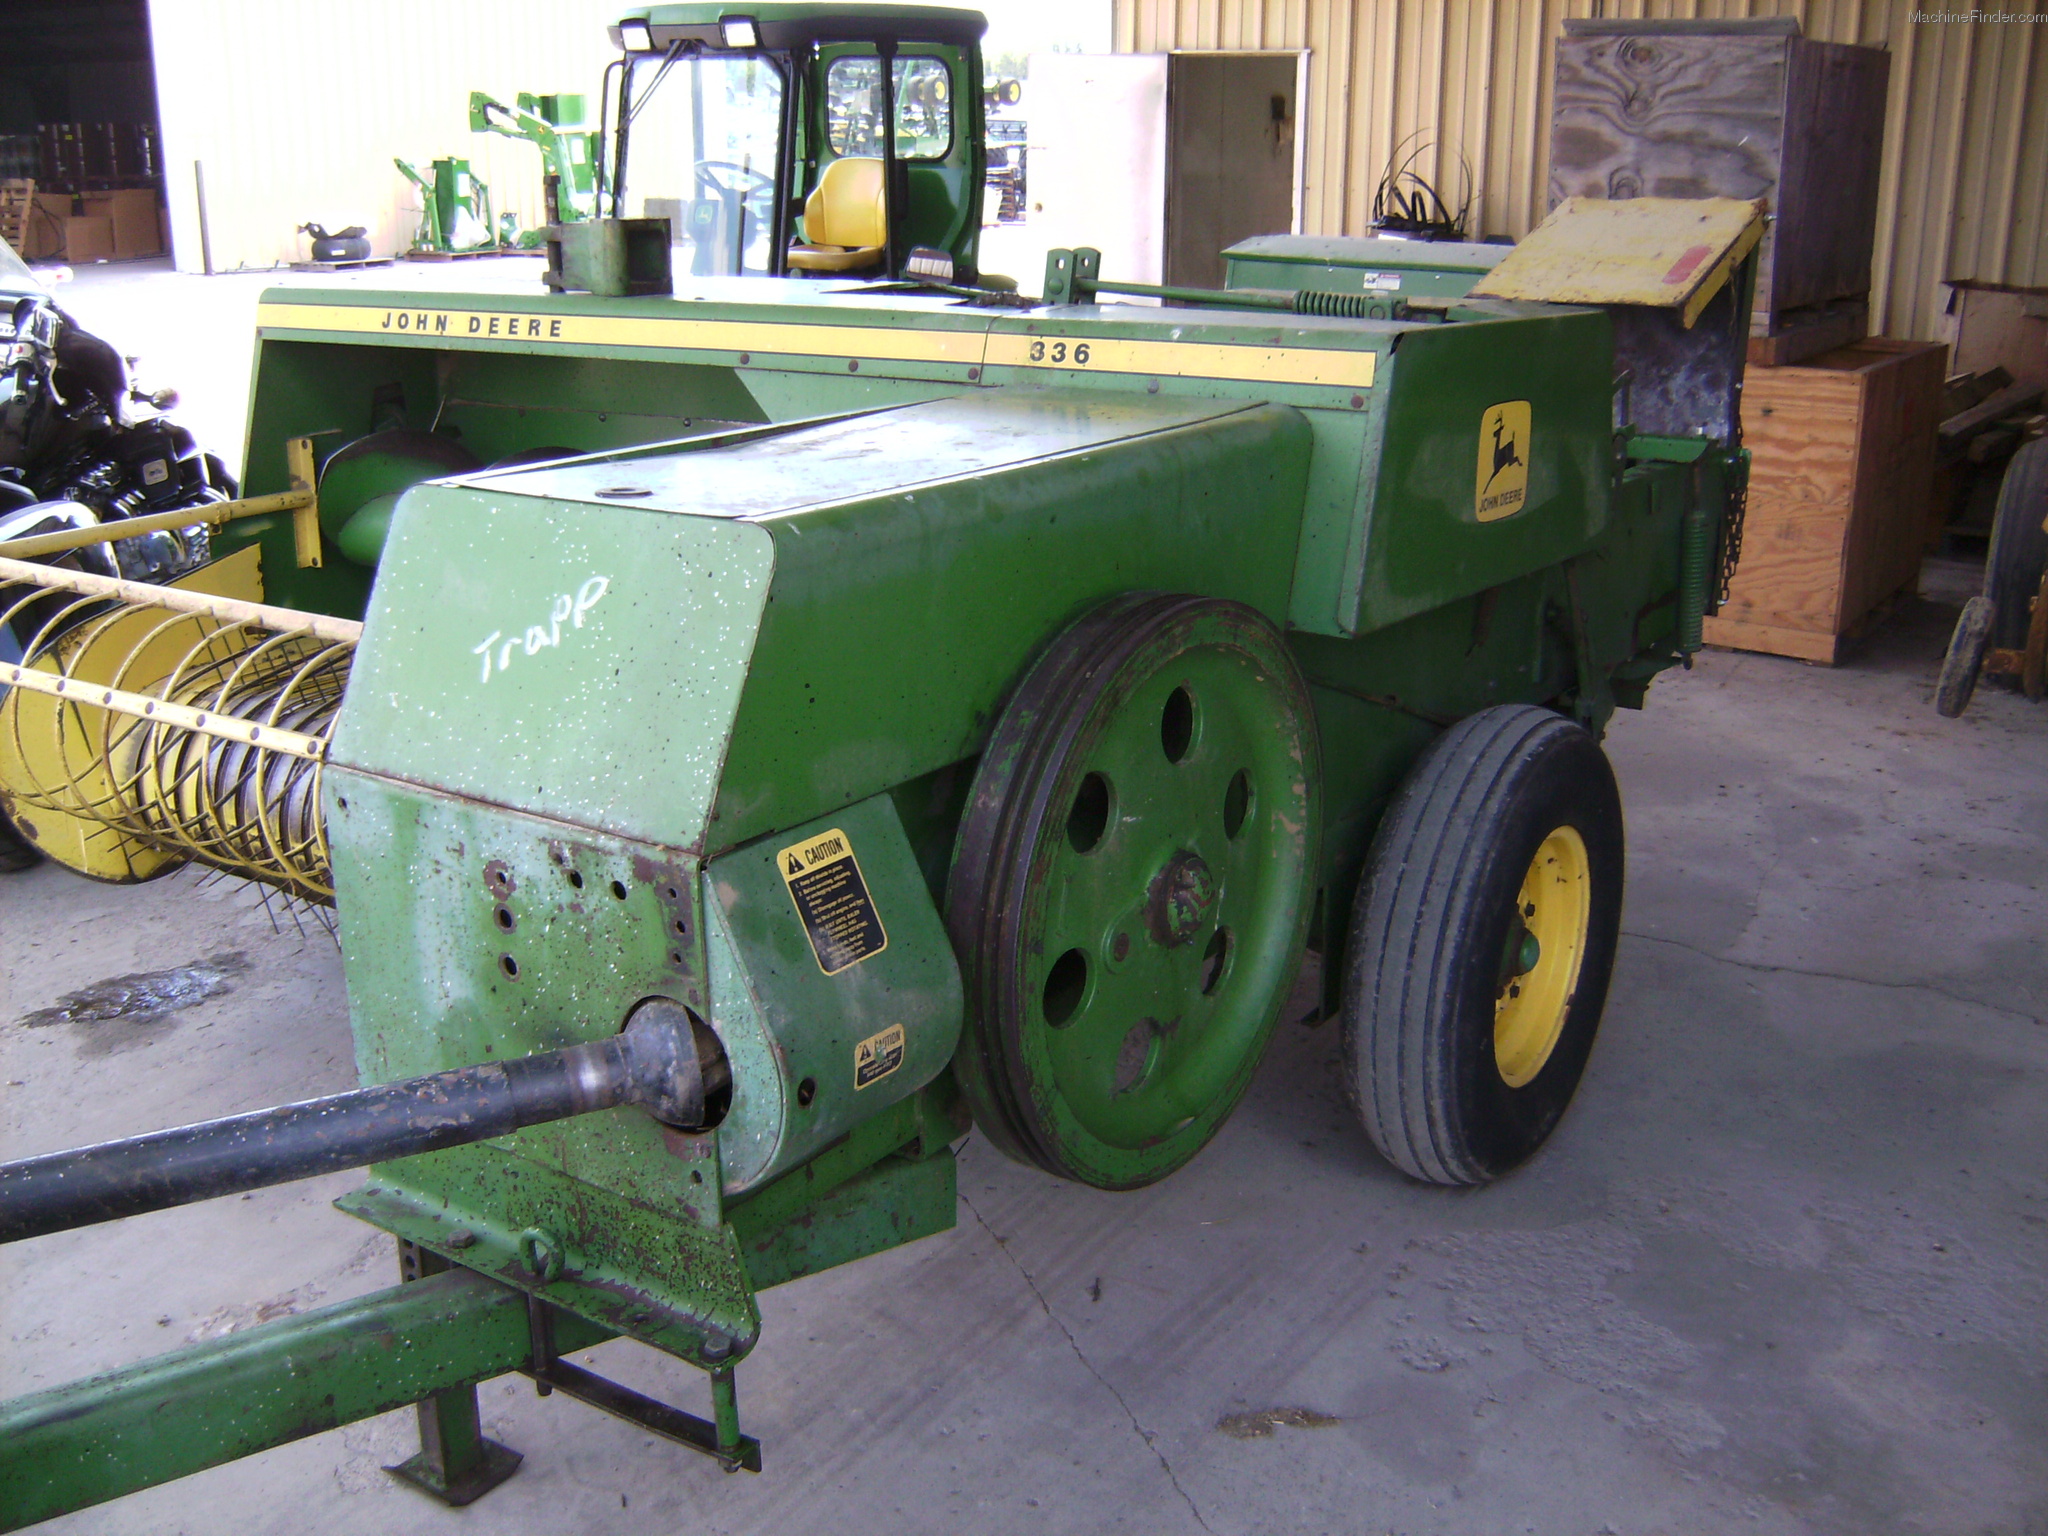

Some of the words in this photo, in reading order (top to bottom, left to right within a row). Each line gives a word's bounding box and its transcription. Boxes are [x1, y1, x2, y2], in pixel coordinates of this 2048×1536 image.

[382, 312, 448, 331] JOHN
[469, 316, 562, 337] DEERE
[1030, 341, 1090, 364] 336
[1479, 494, 1499, 512] JOHN
[1500, 488, 1522, 506] DEERE
[470, 575, 610, 684] Trapp
[804, 837, 844, 865] CAUTION
